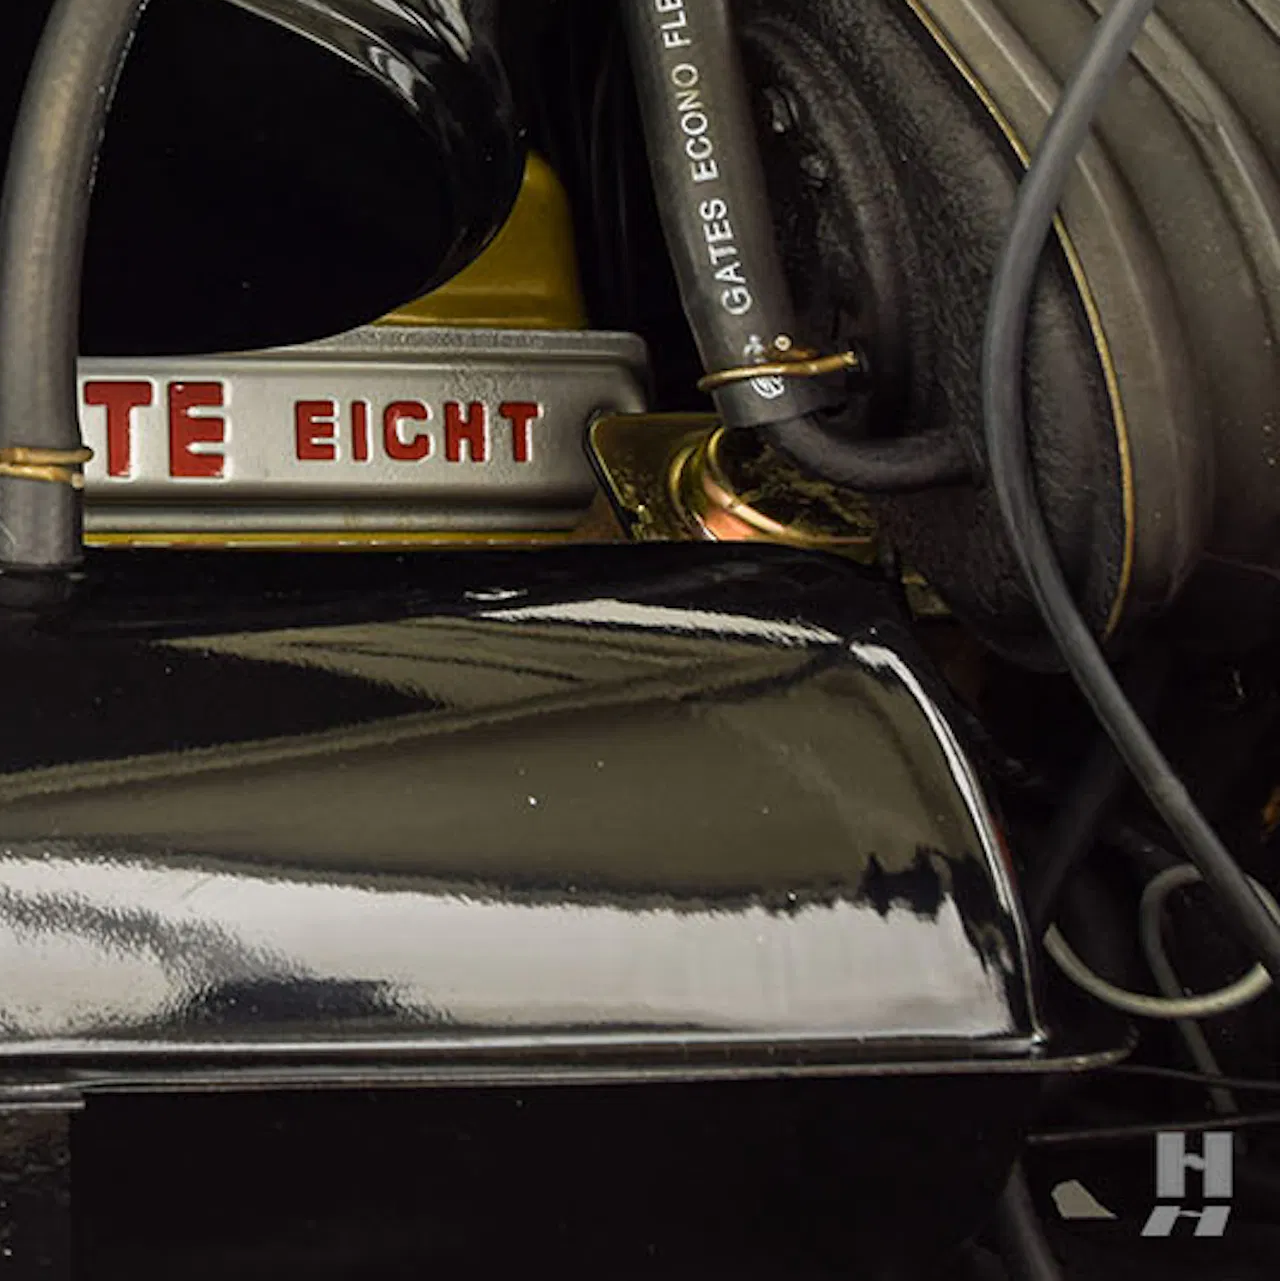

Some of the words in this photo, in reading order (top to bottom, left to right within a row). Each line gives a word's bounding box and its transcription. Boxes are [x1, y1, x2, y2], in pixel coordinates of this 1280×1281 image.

[671, 62, 719, 183] ECONO
[698, 197, 753, 317] GATES
[293, 399, 544, 463] EIGHT
